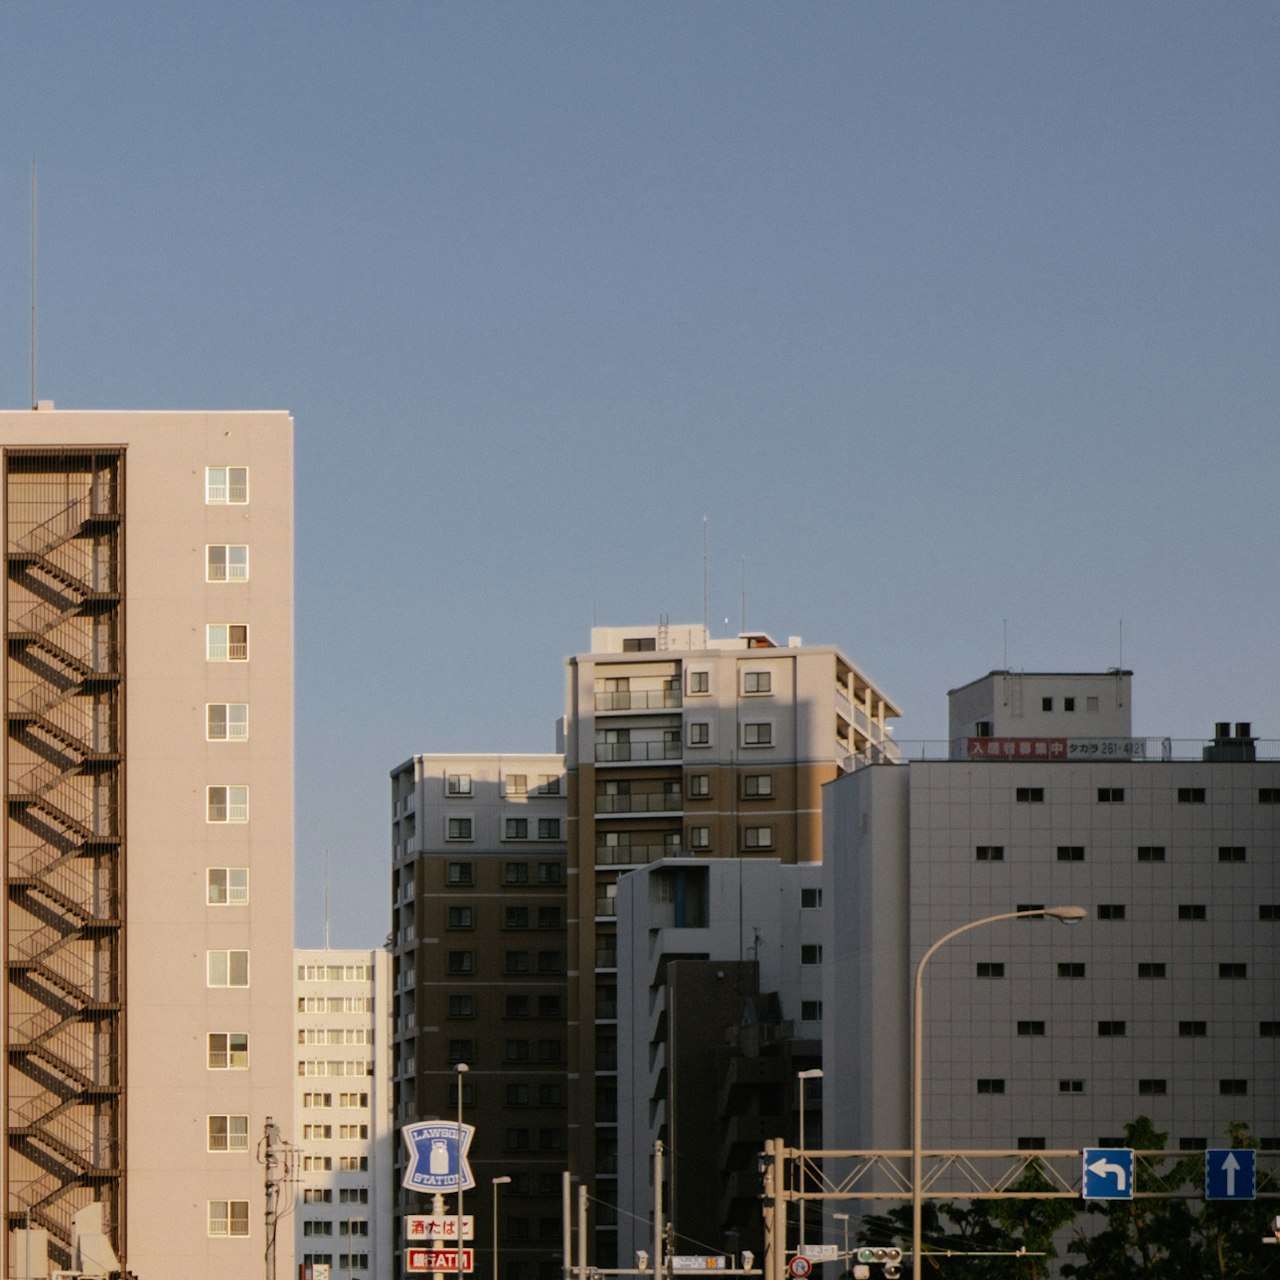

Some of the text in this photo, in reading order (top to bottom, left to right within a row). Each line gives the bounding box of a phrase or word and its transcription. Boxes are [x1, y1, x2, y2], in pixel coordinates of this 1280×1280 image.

[971, 742, 1064, 755] 入居者募集中
[412, 1128, 466, 1141] LAWSON
[412, 1172, 466, 1186] STATION
[412, 1252, 469, 1269] 銀行ATM
